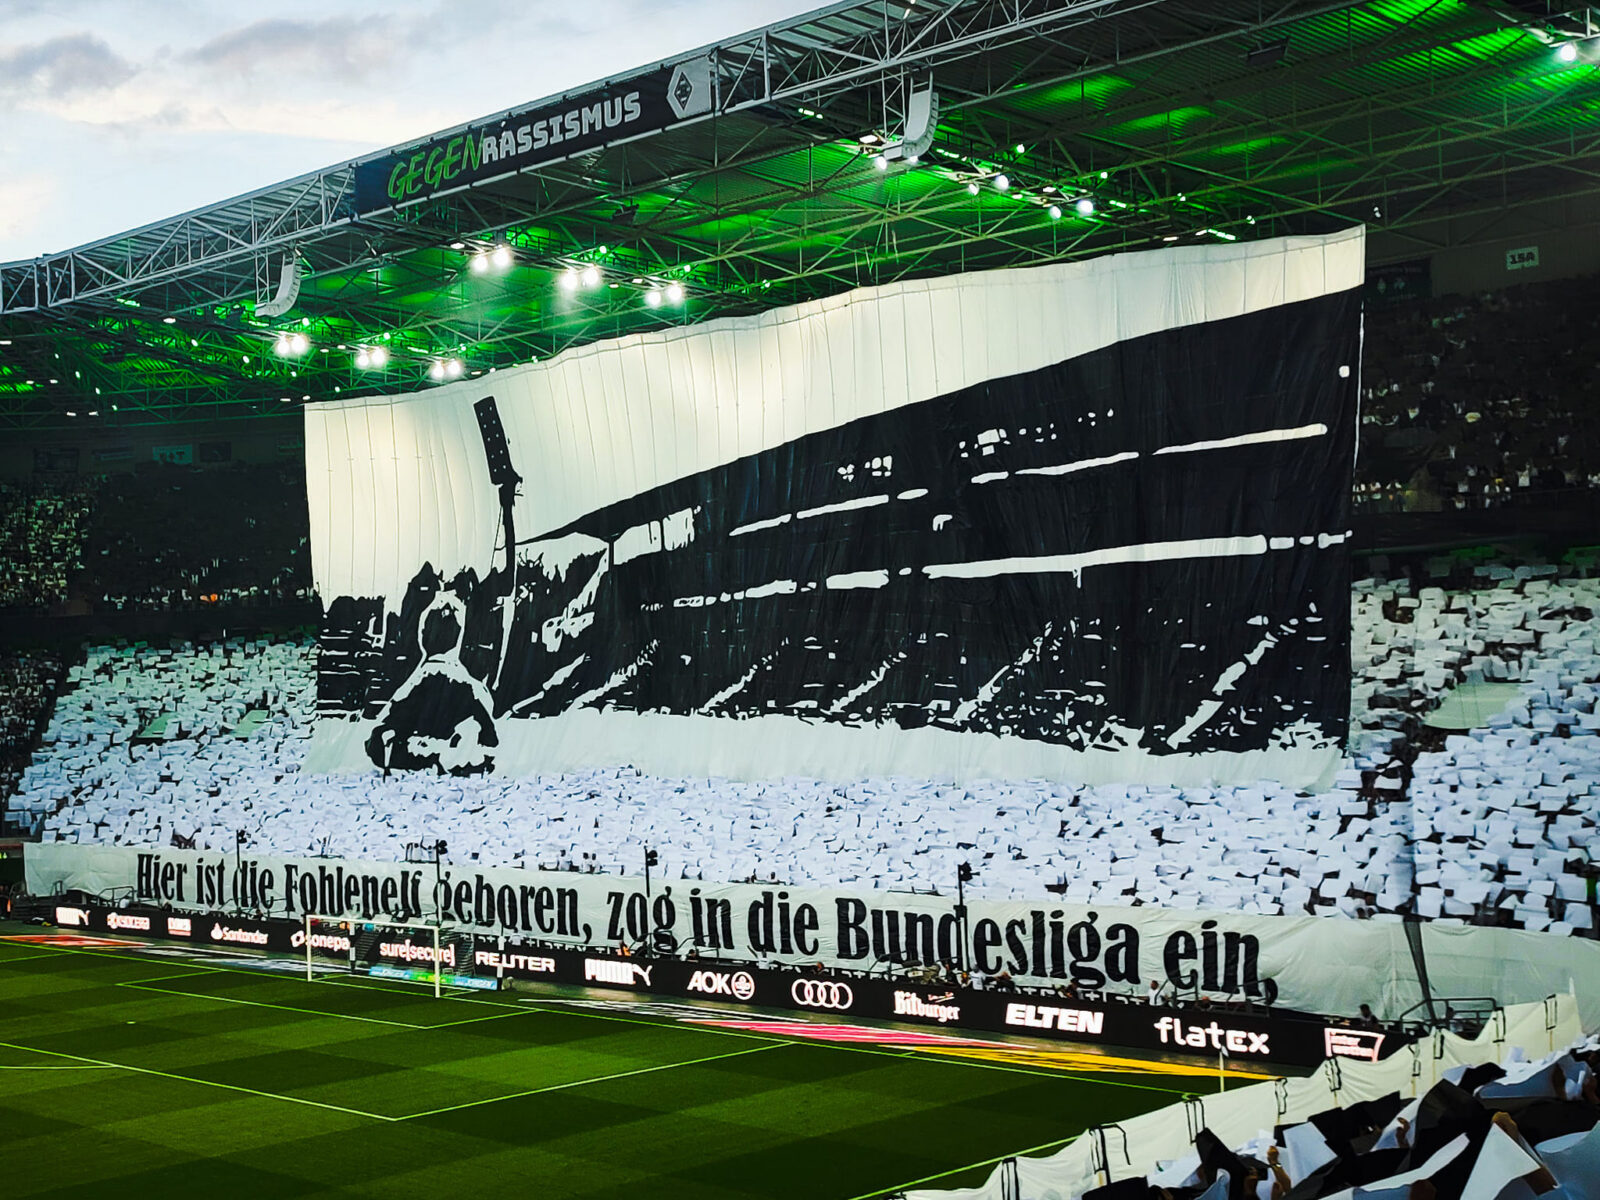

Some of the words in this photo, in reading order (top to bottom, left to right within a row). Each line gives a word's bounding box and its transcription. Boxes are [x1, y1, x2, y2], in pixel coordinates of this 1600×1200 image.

[482, 91, 641, 165] RASSISMUS
[137, 853, 187, 902] Hier
[196, 857, 226, 908] ist
[232, 860, 274, 910] die
[284, 863, 422, 921] Fohlenelf
[433, 871, 592, 944] geboren,
[606, 886, 678, 954] zog
[690, 887, 734, 950] in
[747, 891, 819, 957] die
[834, 897, 1141, 990] Bundesliga
[1163, 919, 1278, 1006] ein,
[223, 926, 269, 945] Santander
[475, 951, 555, 972] REUTER
[687, 970, 732, 995] AOK
[893, 990, 961, 1023] Bitburger
[1005, 1002, 1105, 1035] ELTEN
